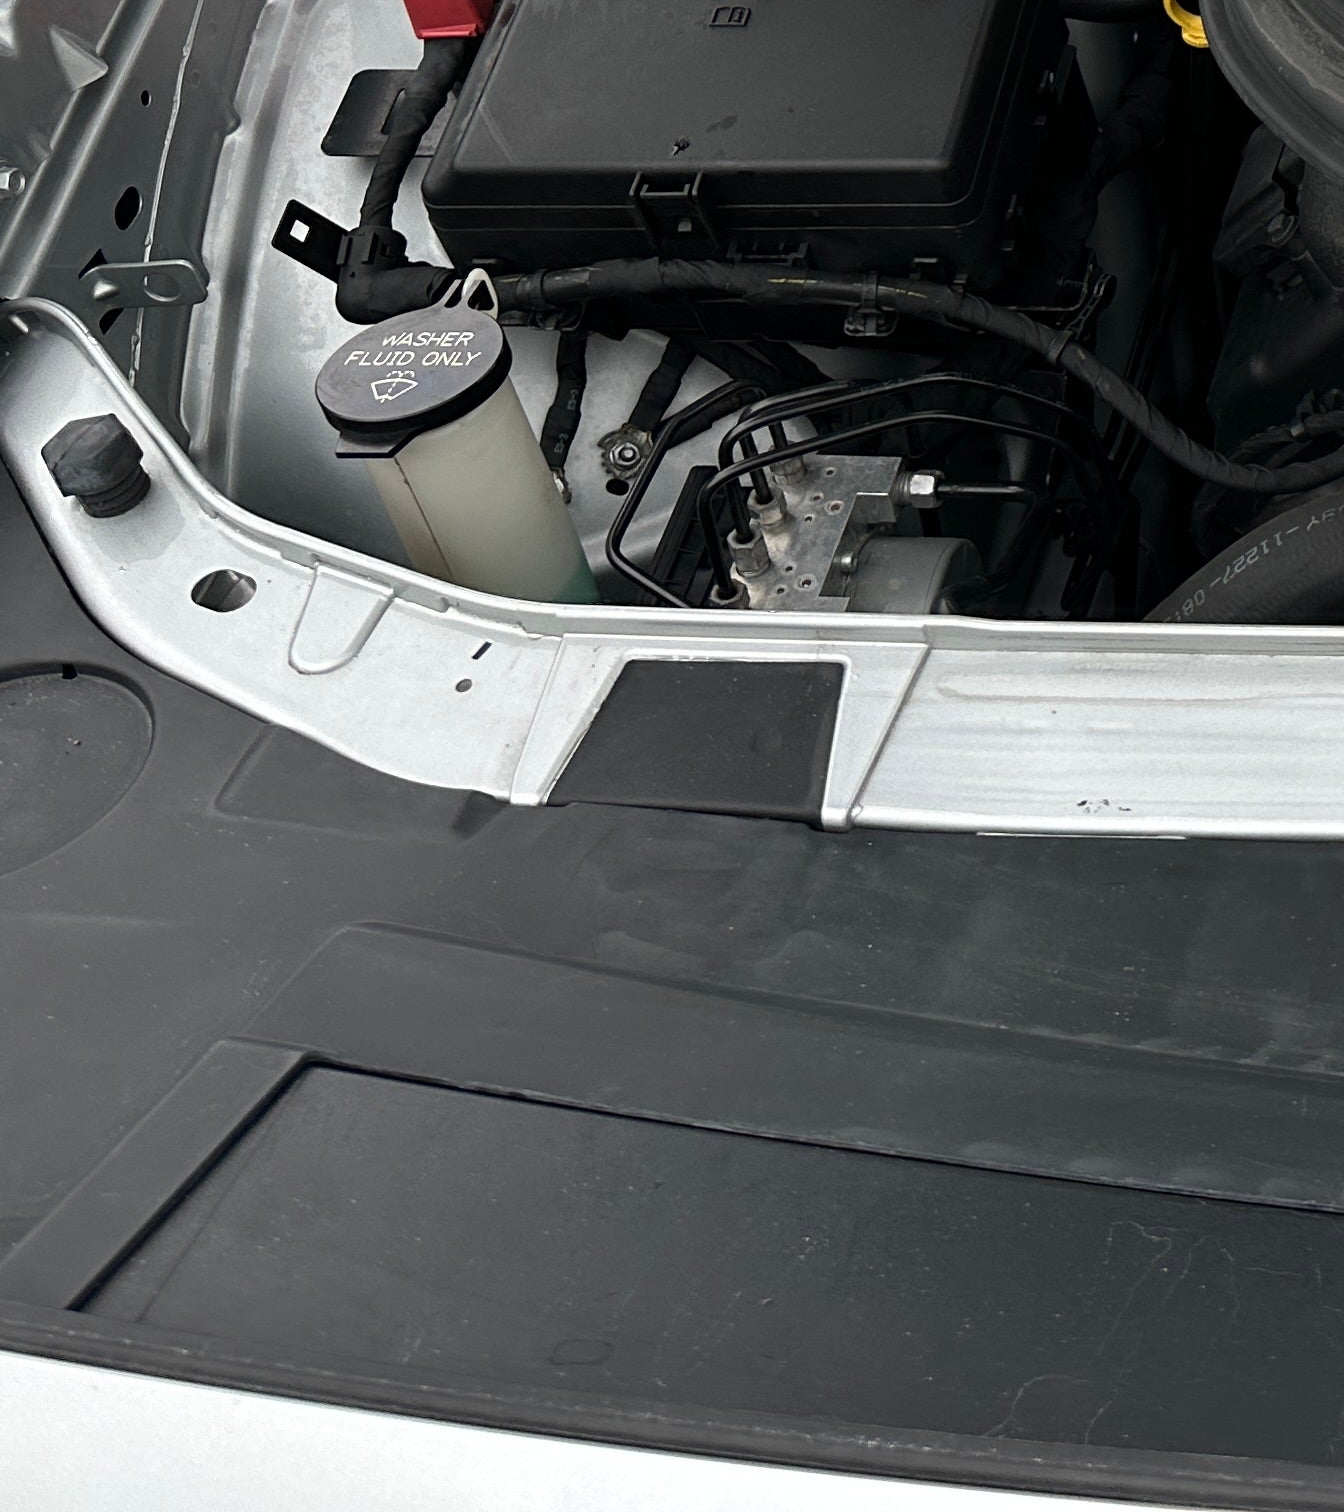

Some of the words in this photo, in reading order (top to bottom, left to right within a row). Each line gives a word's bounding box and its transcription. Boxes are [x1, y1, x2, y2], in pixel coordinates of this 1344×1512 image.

[382, 332, 475, 347] WASHER
[344, 351, 415, 366] FLUID
[421, 351, 481, 366] ONLY
